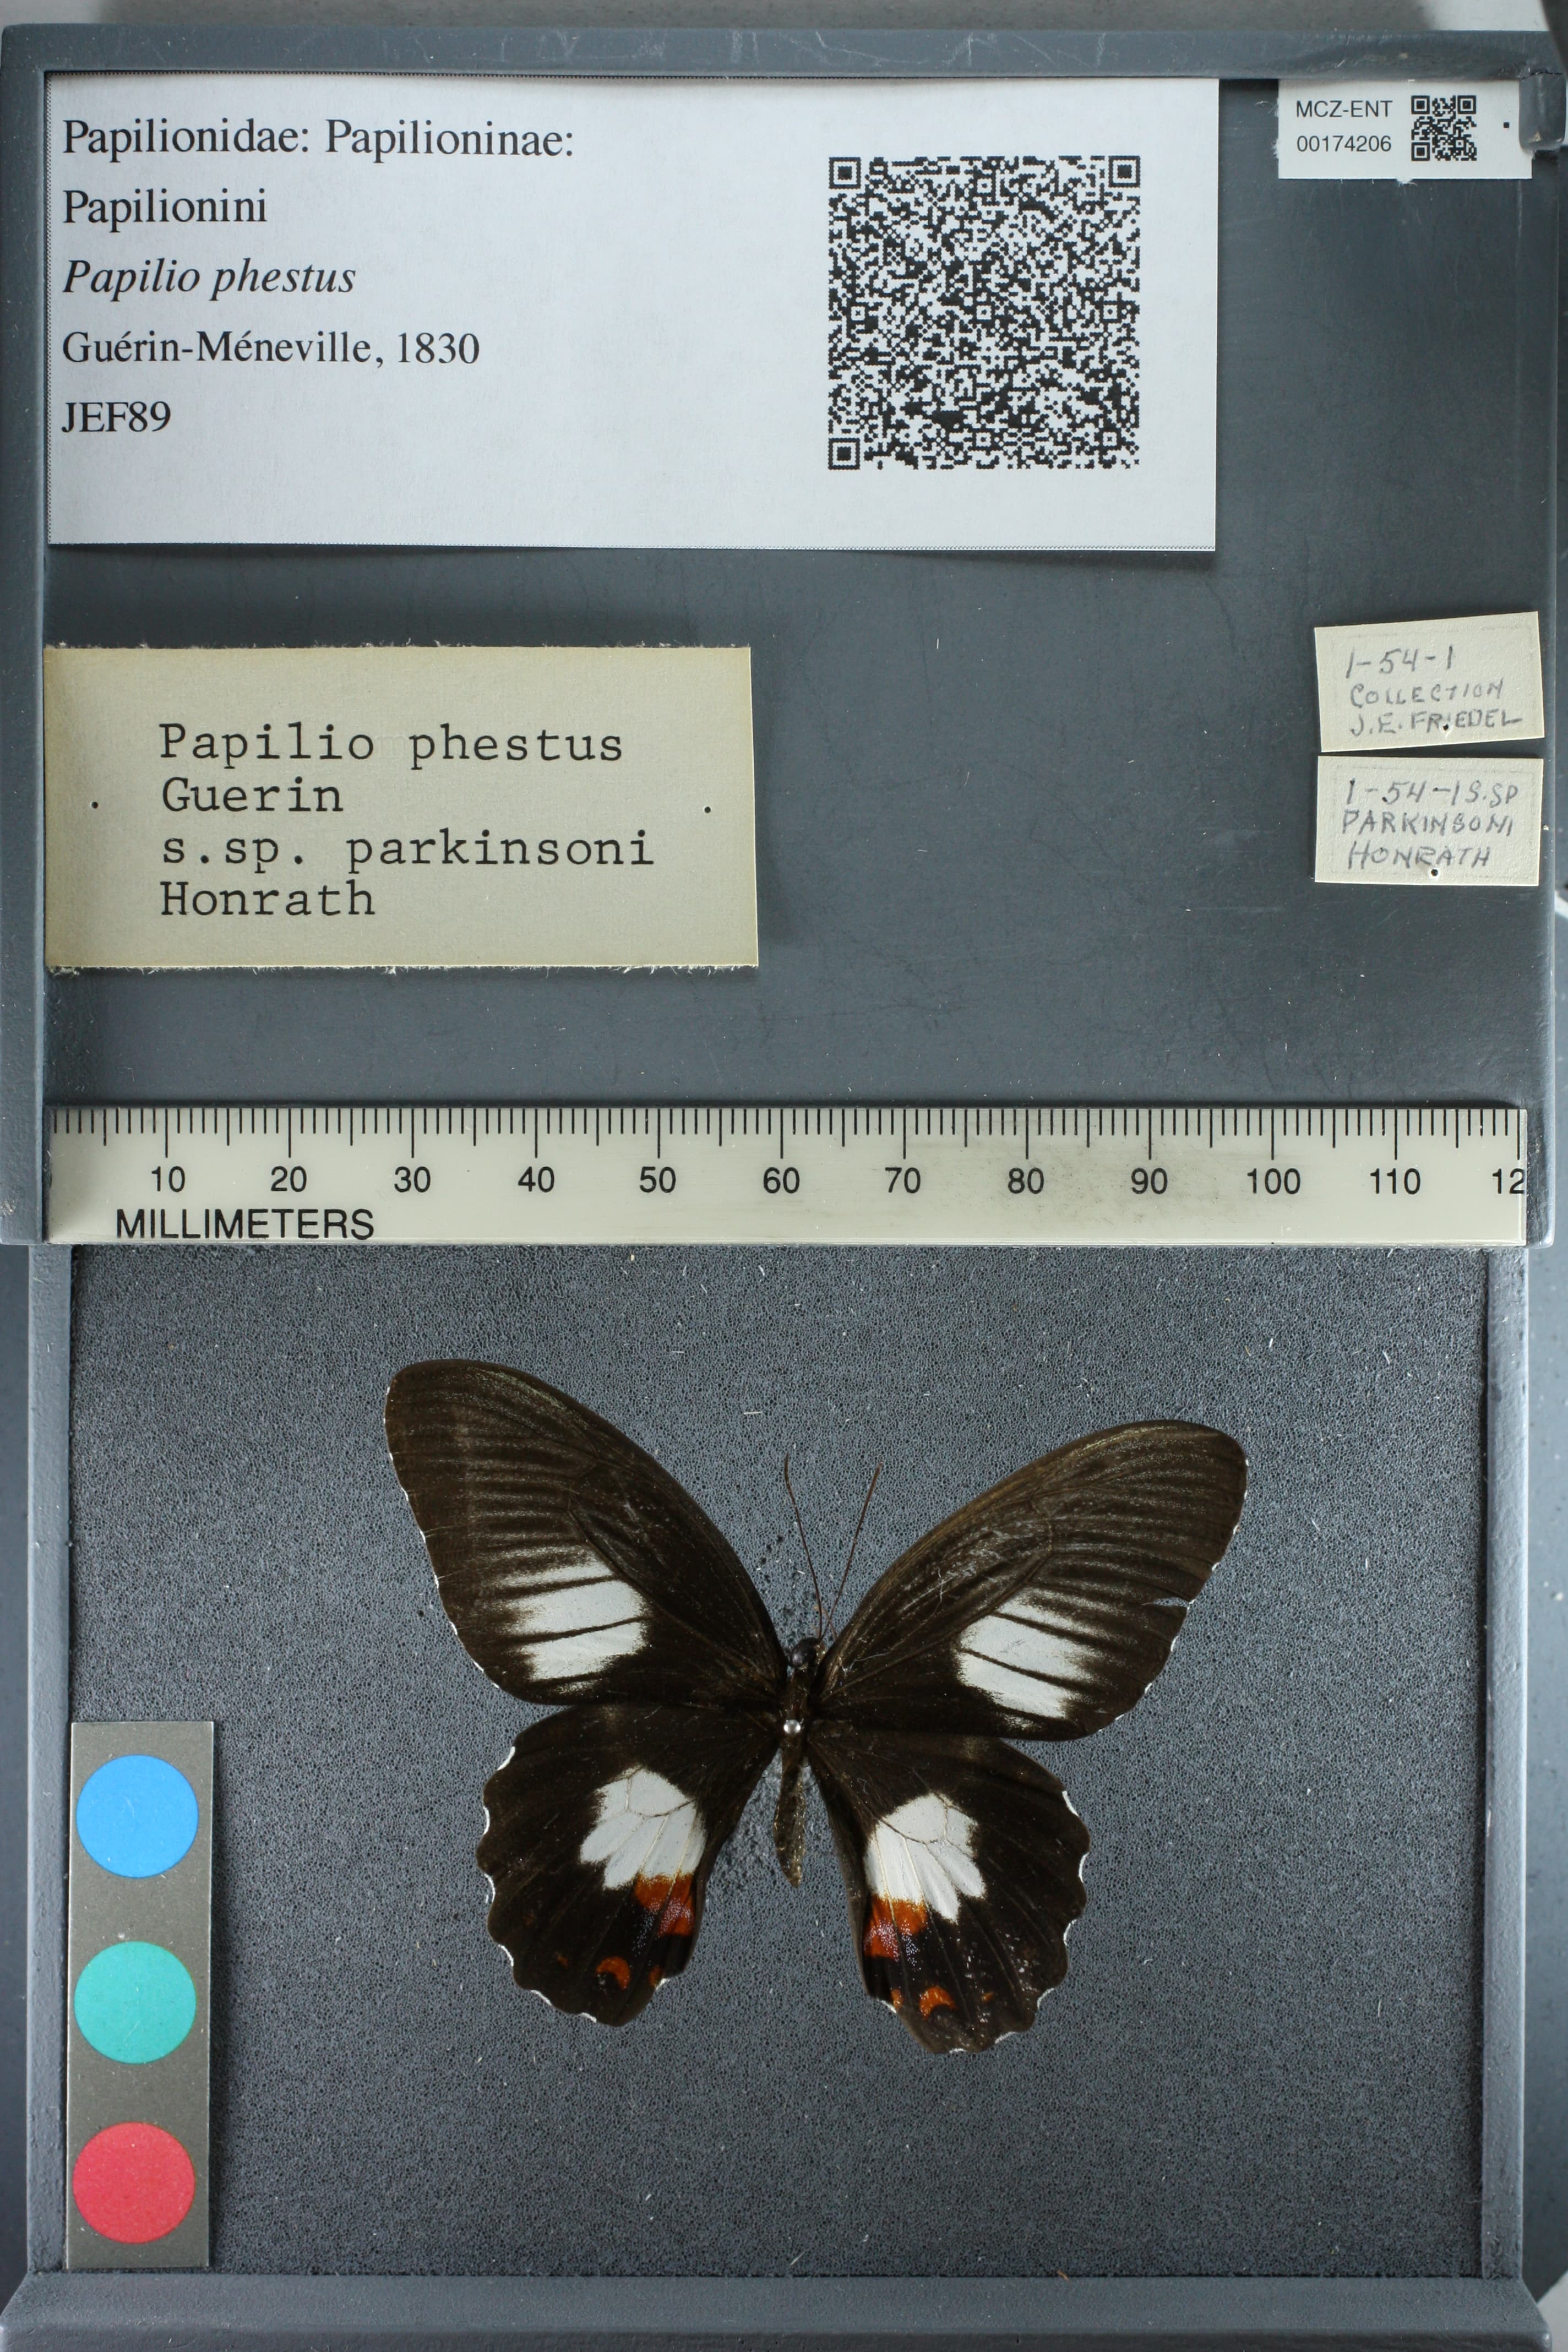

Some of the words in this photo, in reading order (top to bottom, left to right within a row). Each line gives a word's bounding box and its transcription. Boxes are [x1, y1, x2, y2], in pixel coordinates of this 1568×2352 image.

[1297, 100, 1393, 117] MCZ-ENT
[63, 117, 308, 163] Papilionidae:
[325, 119, 572, 164] Papilioninae:
[1297, 135, 1391, 152] 00174206
[63, 188, 266, 233] Papilionini
[62, 258, 200, 302] Papilio
[209, 257, 356, 301] phestus
[63, 330, 383, 367] Guérin-Méneville,
[399, 333, 480, 364] 1830
[61, 401, 171, 433] JEF89
[1349, 677, 1505, 708] COLLECTION
[159, 721, 374, 769] Papilio
[409, 723, 622, 770] phestus
[162, 776, 344, 812] Guerin
[1341, 809, 1514, 836] PARKINSONI
[163, 836, 303, 874] s.sp.
[346, 827, 654, 874] parkinsoni
[1347, 840, 1491, 869] HONRATH
[160, 879, 375, 916] Honrath
[151, 1166, 186, 1193] 10
[271, 1166, 307, 1193] 20
[394, 1166, 431, 1193] 30
[518, 1166, 555, 1193] 40
[639, 1166, 676, 1193] 50
[763, 1167, 800, 1194] 60
[885, 1167, 921, 1194] 70
[1008, 1167, 1044, 1194] 80
[1131, 1168, 1168, 1195] 90
[1247, 1168, 1301, 1195] 100
[1370, 1168, 1421, 1195] 110
[117, 1208, 374, 1240] MILLIMETERS
